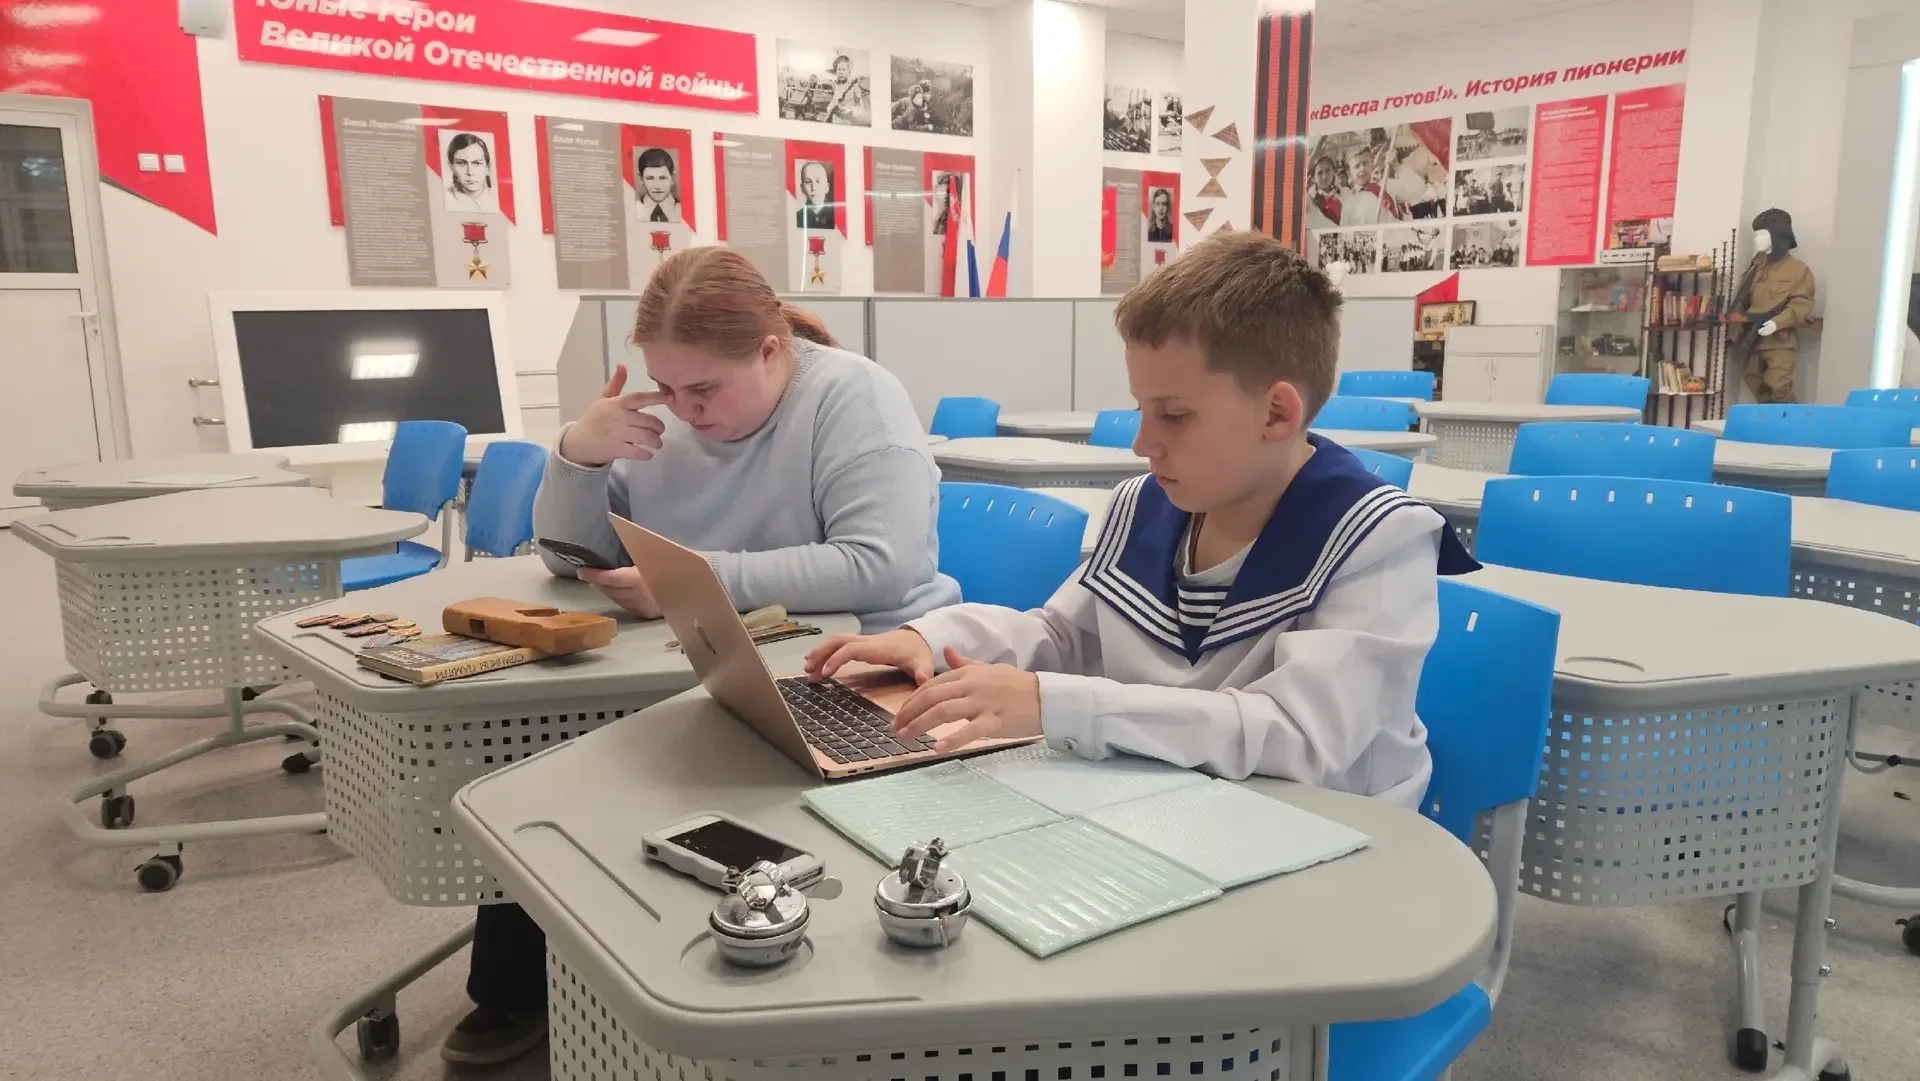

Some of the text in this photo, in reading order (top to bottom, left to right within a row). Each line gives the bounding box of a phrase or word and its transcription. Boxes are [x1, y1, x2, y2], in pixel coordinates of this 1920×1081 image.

[377, 2, 476, 34] герои
[261, 20, 743, 99] Великой Отечественной войны
[1309, 47, 1687, 122] «Всегда готов!». История пионерии
[435, 663, 476, 680] ПАМЯТИ
